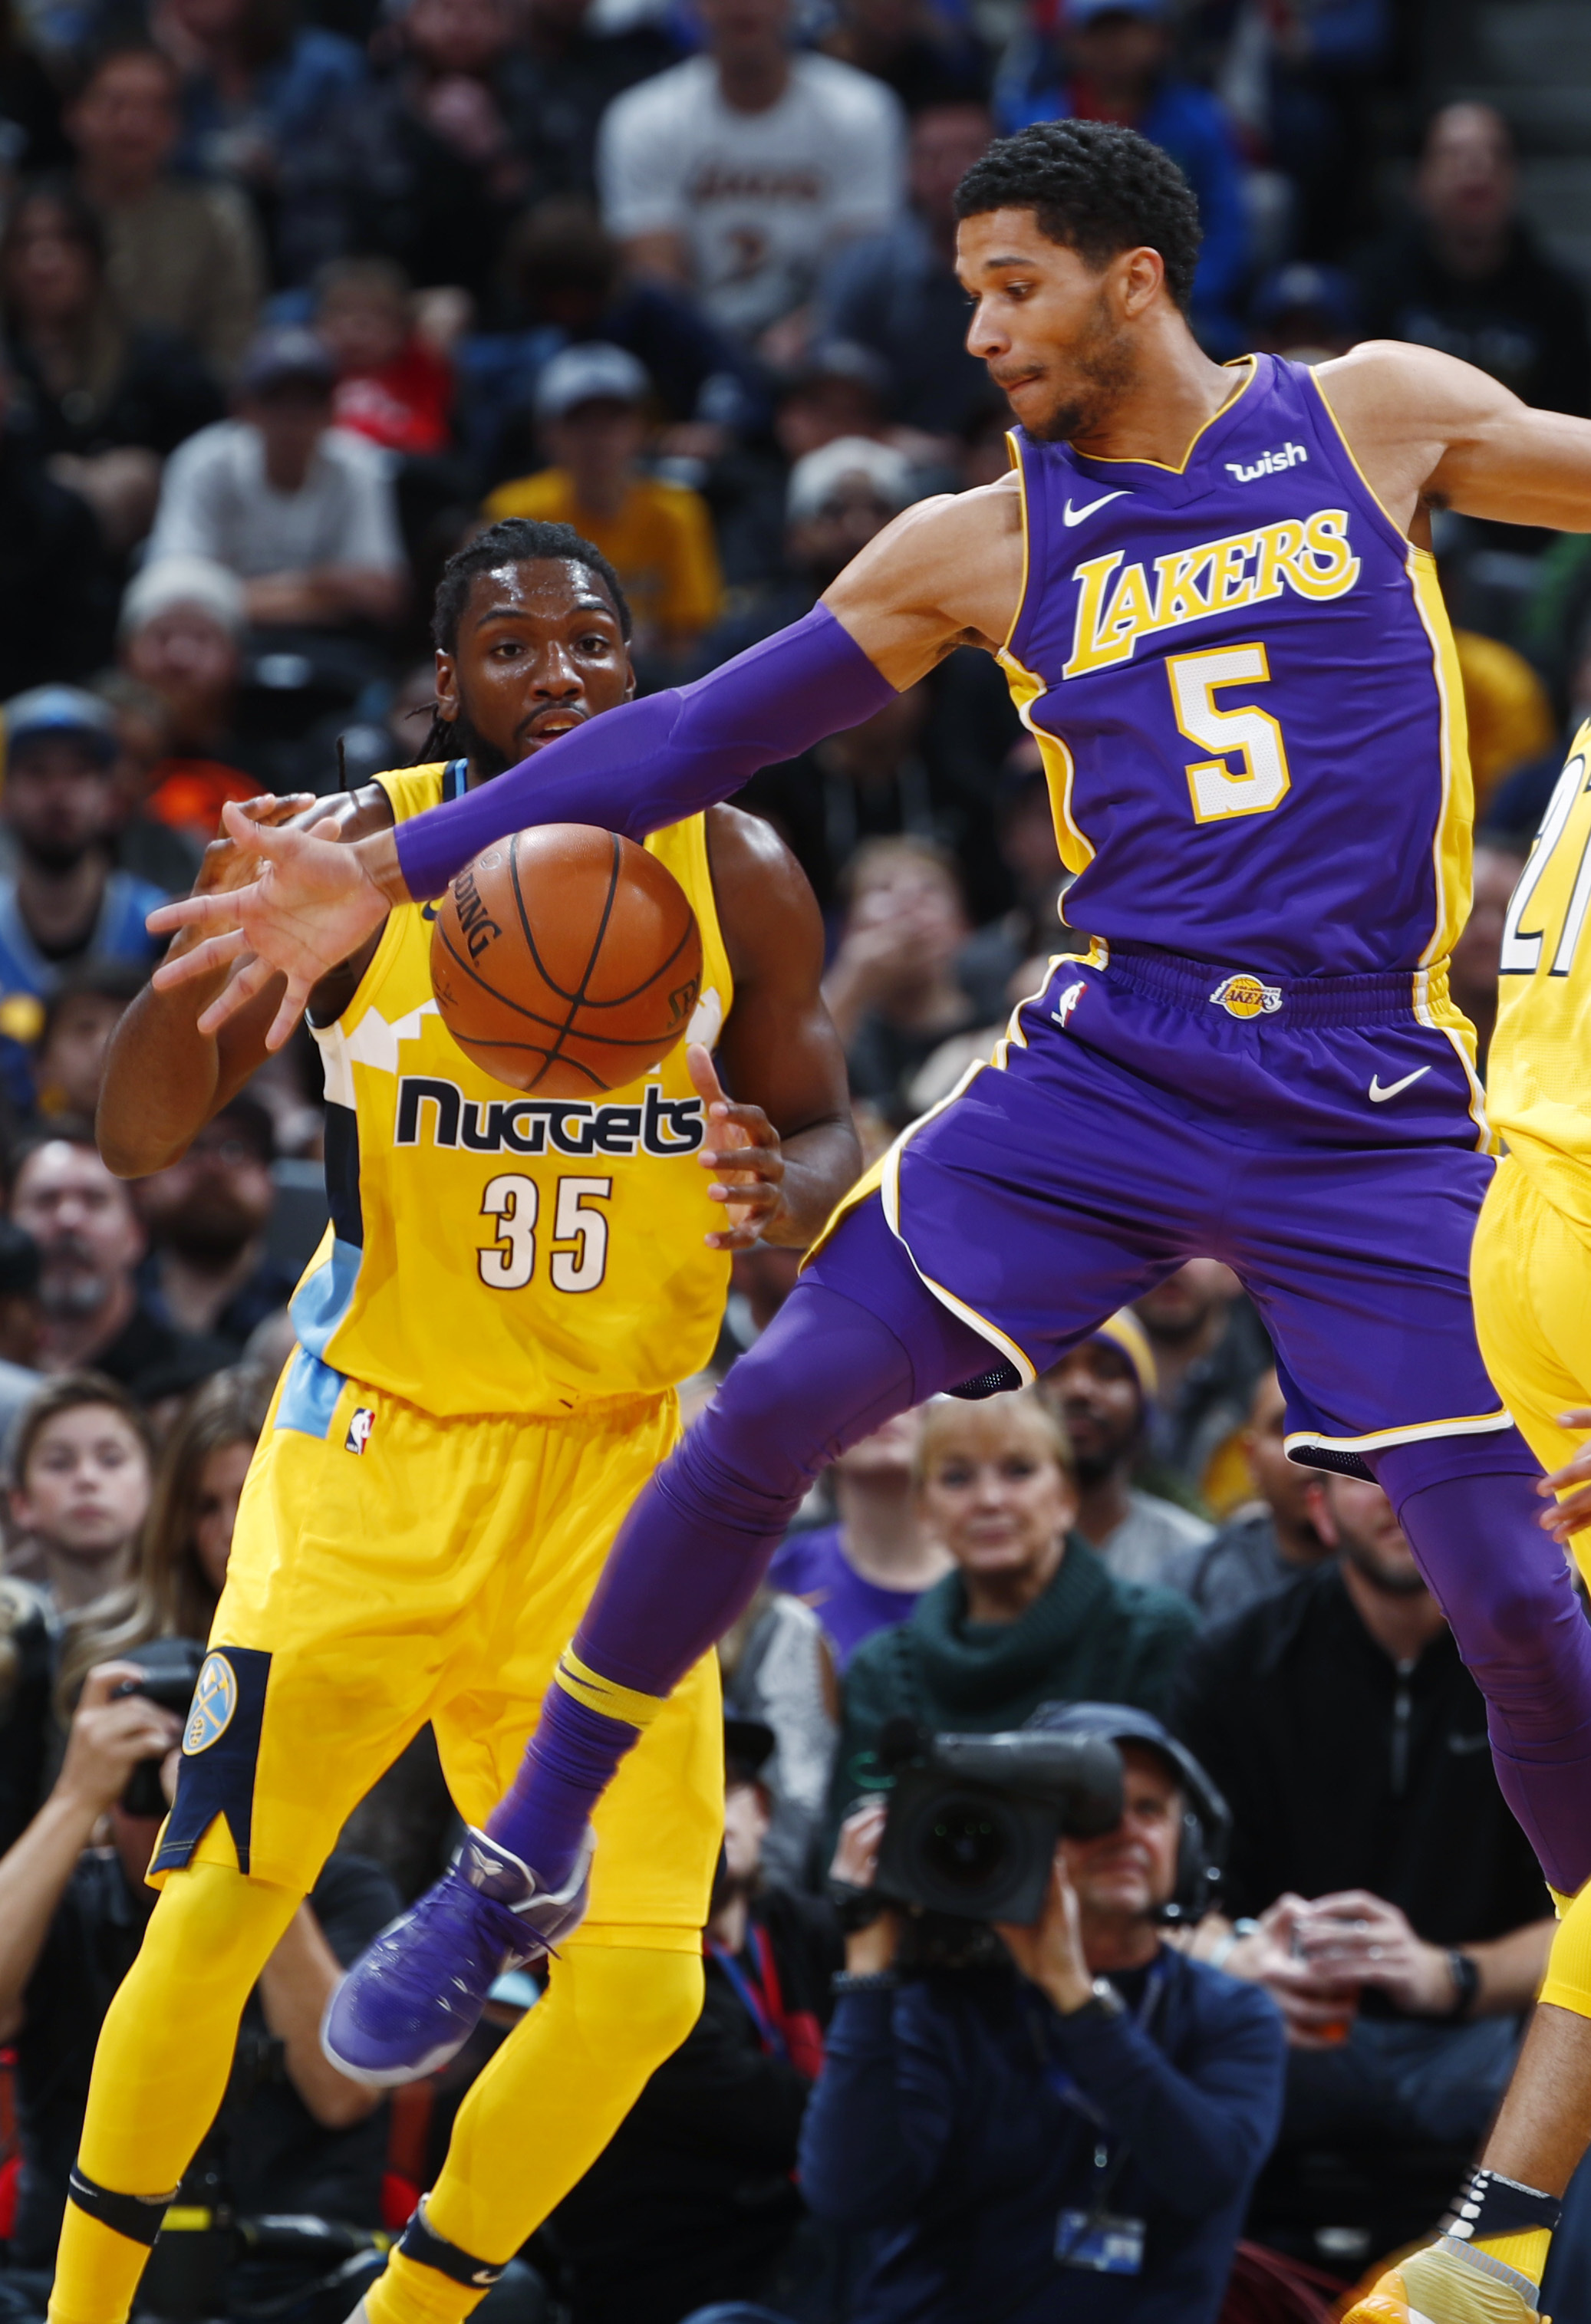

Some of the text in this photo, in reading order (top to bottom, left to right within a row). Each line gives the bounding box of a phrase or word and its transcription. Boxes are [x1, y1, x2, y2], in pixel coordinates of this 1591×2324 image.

[1225, 442, 1308, 482] wish
[1062, 509, 1361, 680] LAKERS
[1164, 642, 1292, 825] 5
[454, 871, 503, 960] DING
[476, 1173, 613, 1293] 35
